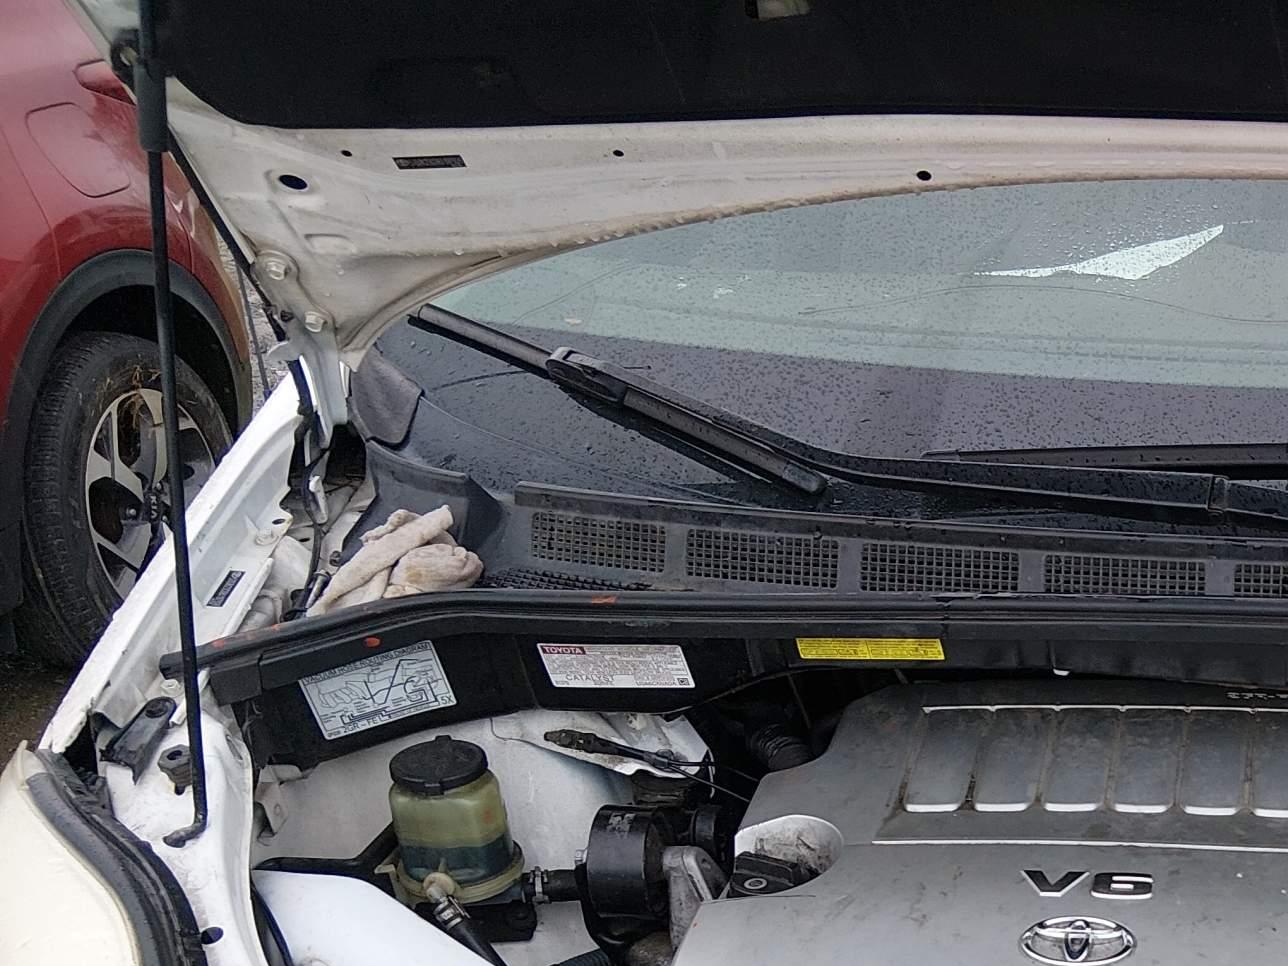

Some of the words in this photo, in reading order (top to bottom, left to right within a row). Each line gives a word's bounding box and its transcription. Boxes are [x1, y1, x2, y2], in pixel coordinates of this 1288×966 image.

[542, 646, 583, 654] TOYOTA
[565, 674, 615, 682] CATALYST
[1020, 868, 1154, 900] V6
